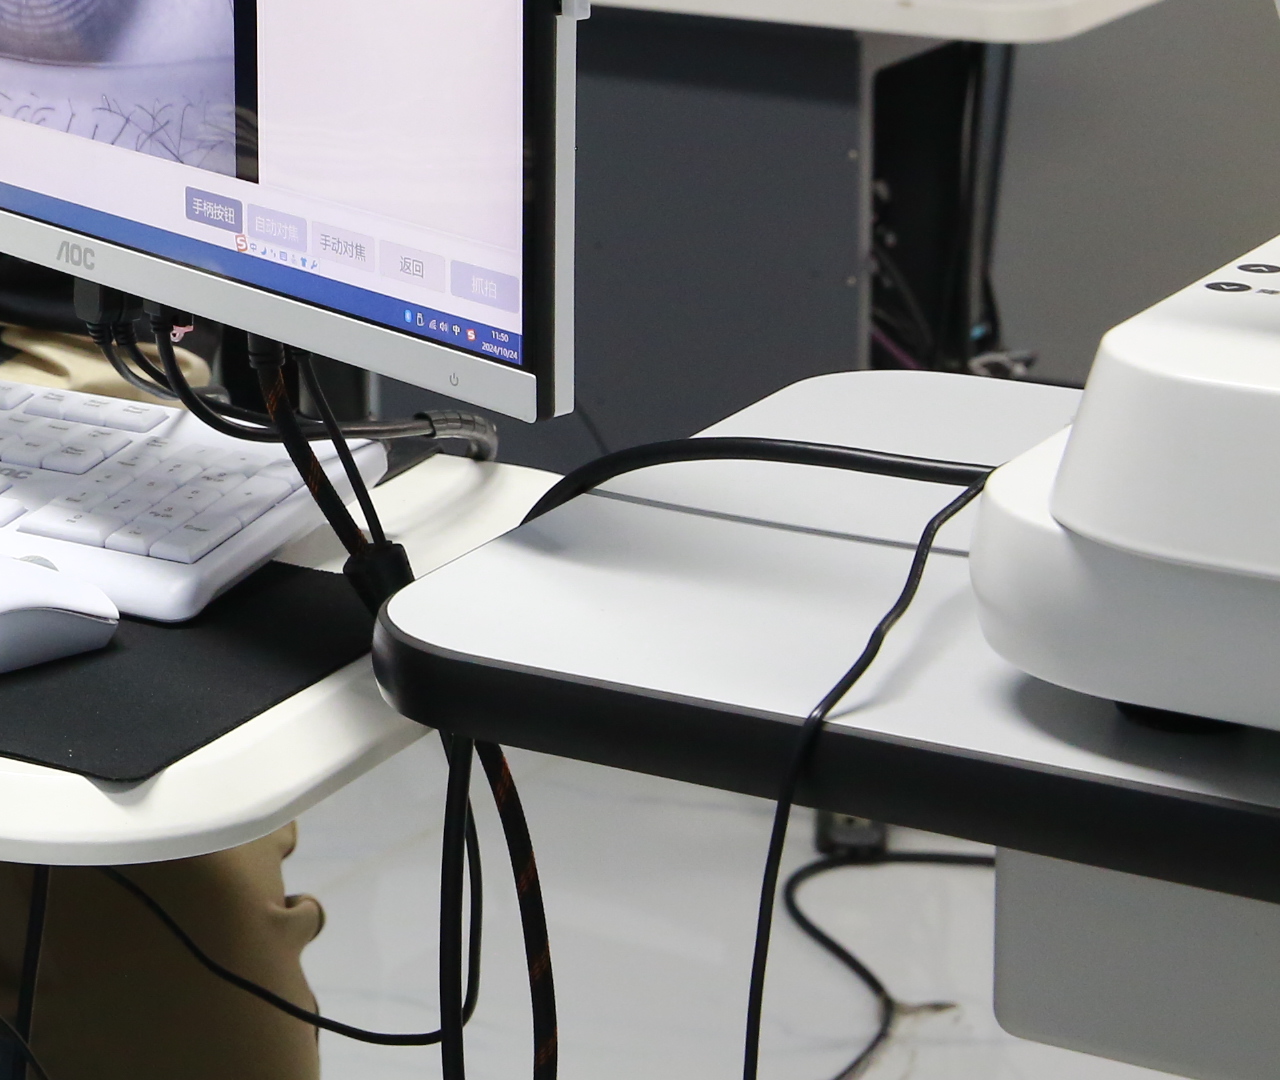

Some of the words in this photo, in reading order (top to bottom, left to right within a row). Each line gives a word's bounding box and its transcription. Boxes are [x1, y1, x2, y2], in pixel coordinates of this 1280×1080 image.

[192, 197, 236, 225] 手柄按钮
[255, 216, 299, 242] 自动对焦
[56, 240, 95, 270] AOC
[320, 233, 367, 262] 手动对焦
[399, 256, 424, 279] 返回
[472, 275, 497, 299] 抓拍
[491, 330, 509, 343] 11:50
[481, 341, 519, 360] 2024/10/24
